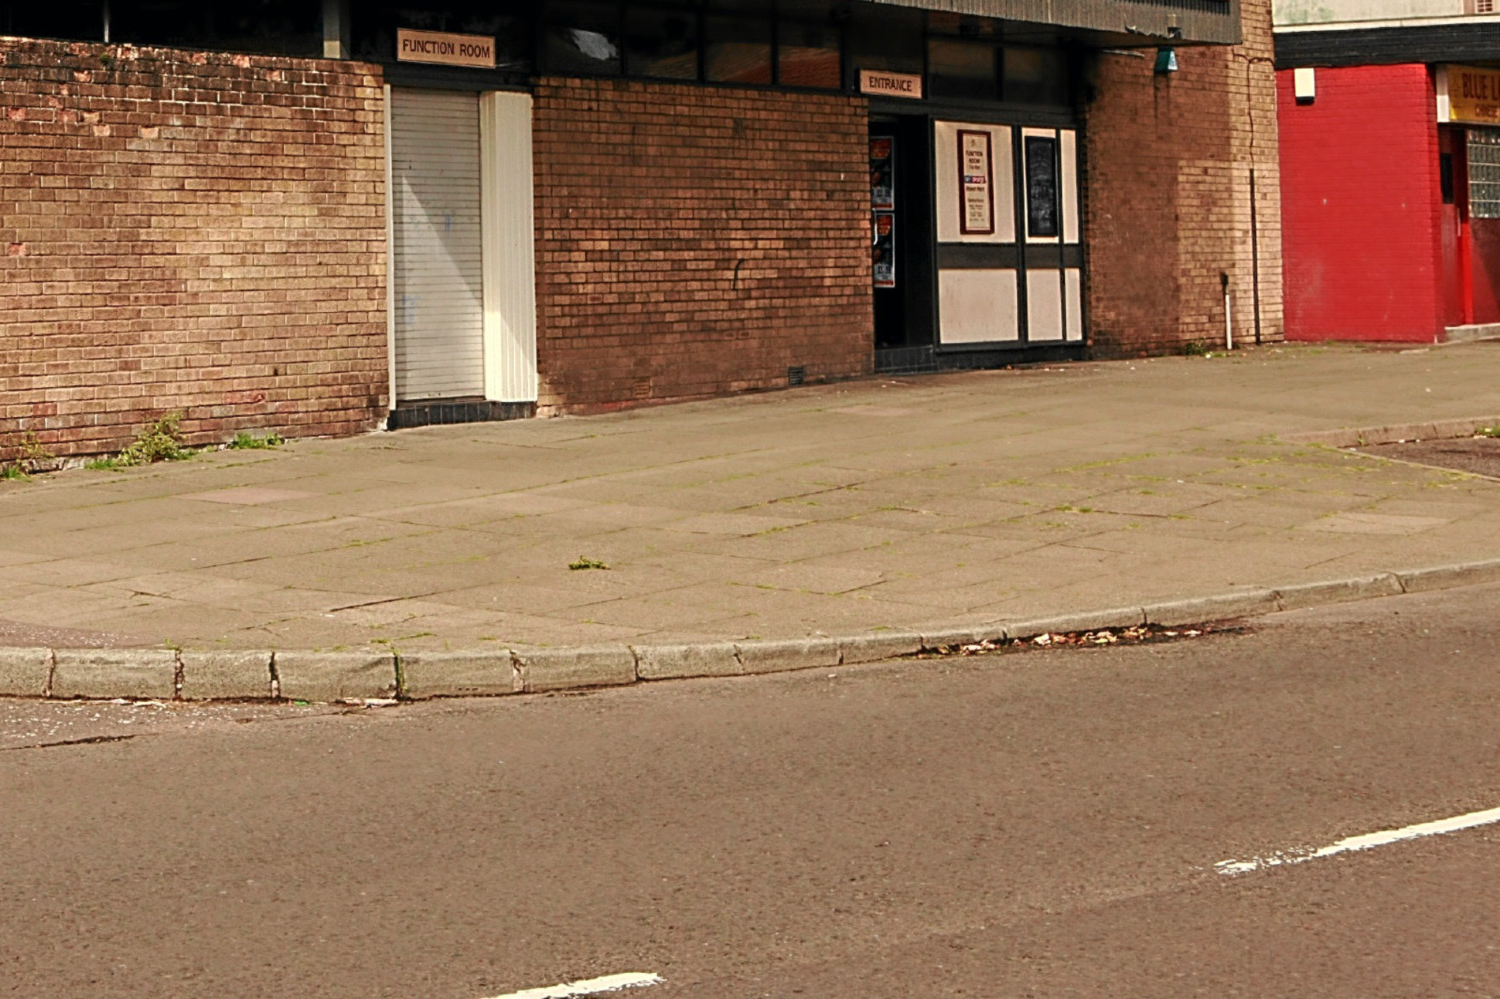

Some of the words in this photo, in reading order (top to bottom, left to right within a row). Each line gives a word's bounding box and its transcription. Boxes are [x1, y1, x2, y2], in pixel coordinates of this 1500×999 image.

[402, 39, 455, 55] FUNCTION
[459, 44, 491, 58] ROOM
[868, 76, 913, 92] ENTRANCE
